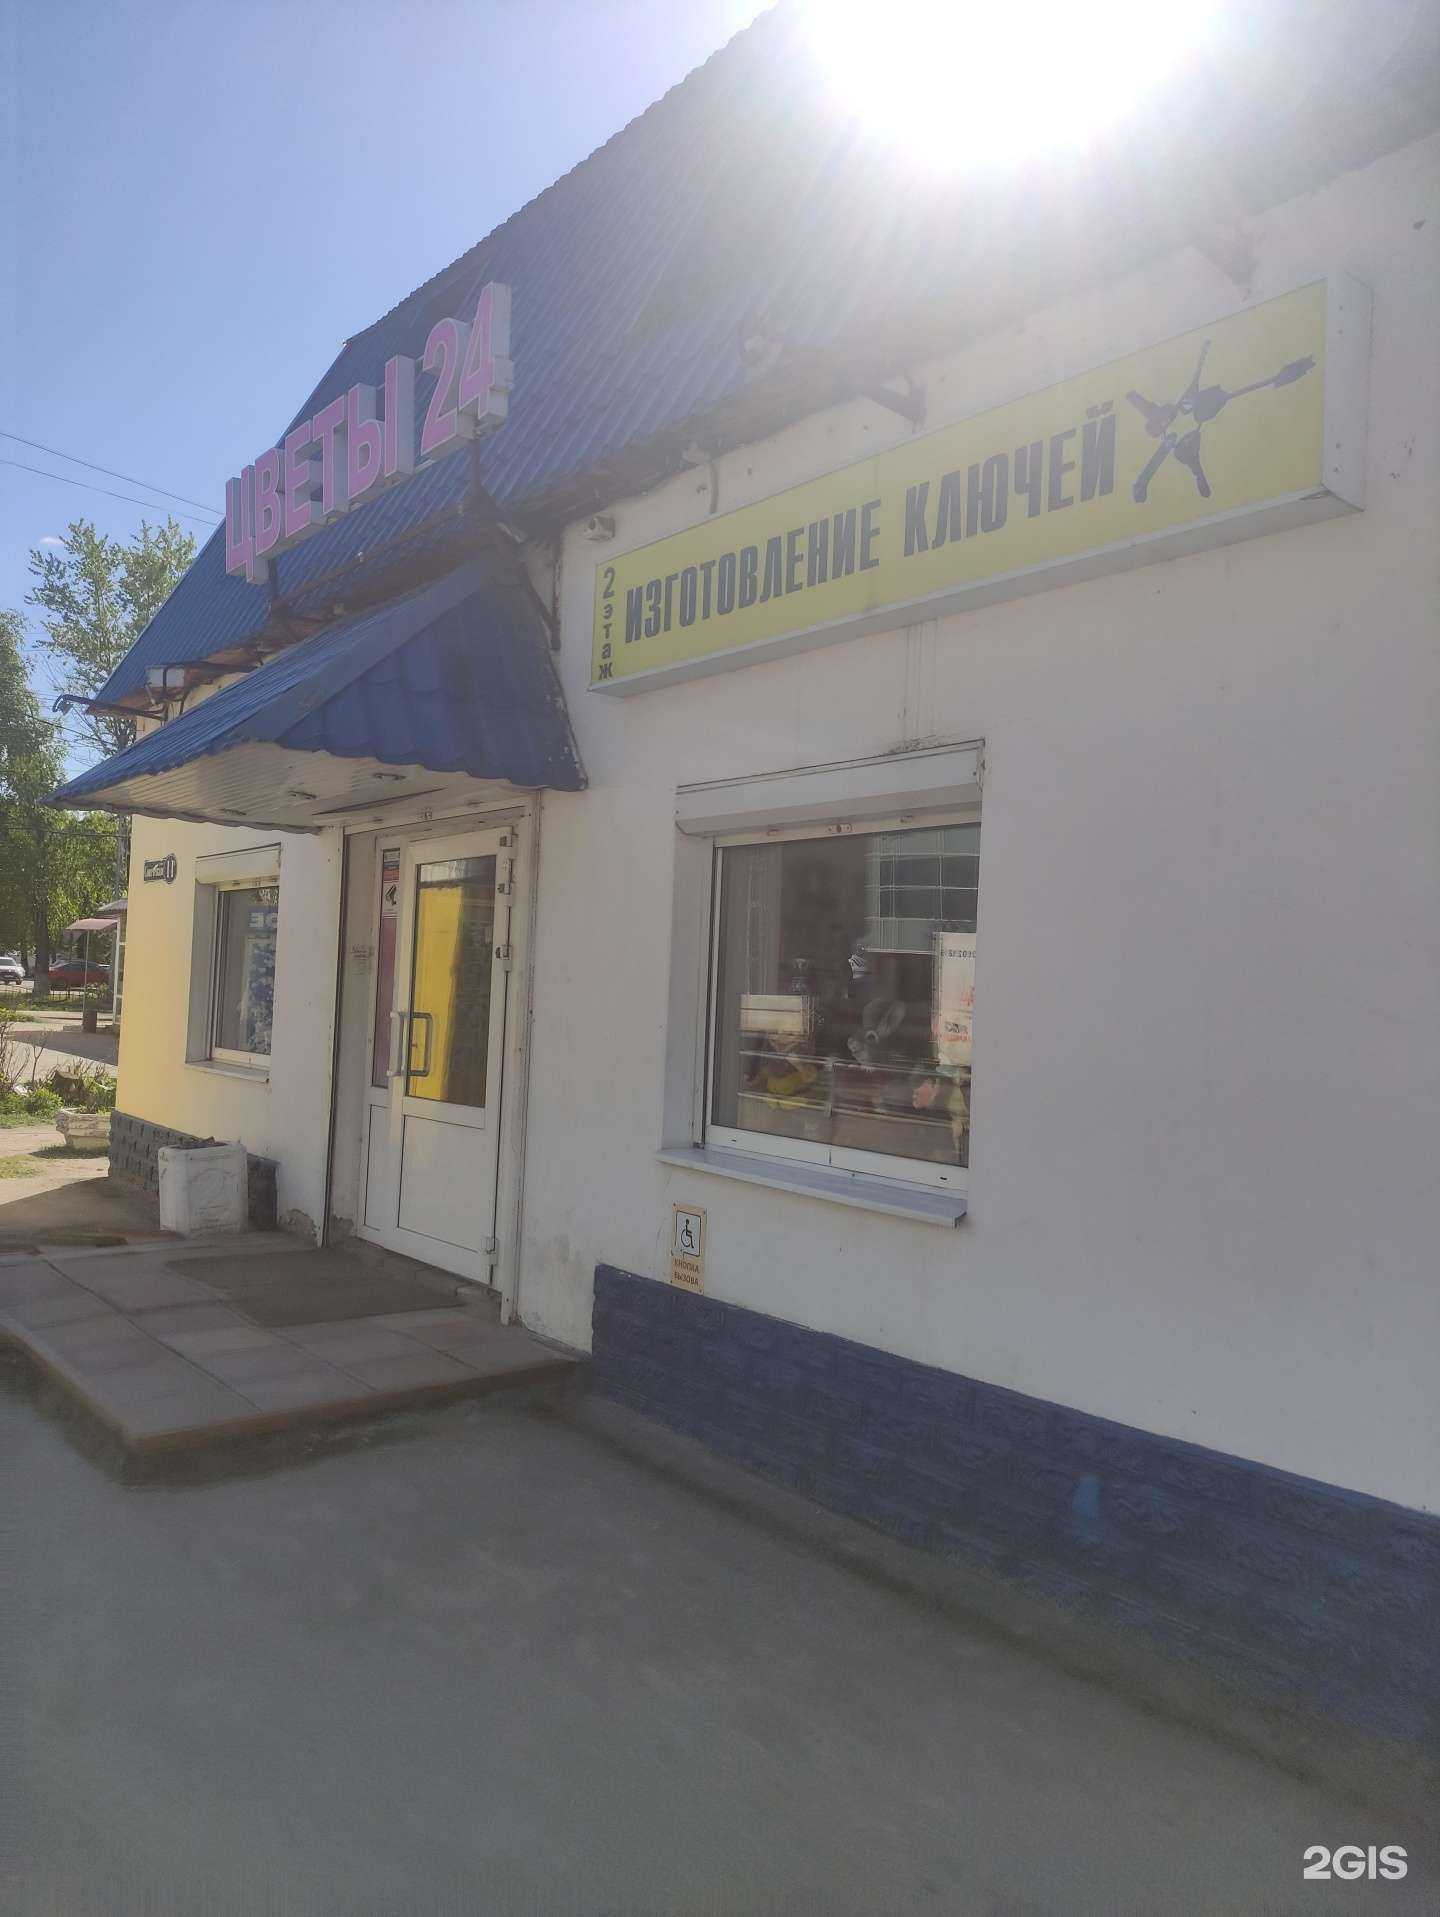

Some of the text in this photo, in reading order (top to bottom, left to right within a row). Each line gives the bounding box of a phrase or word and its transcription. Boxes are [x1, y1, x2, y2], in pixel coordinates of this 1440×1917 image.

[225, 281, 502, 584] ЦВЕТЫ 24
[625, 400, 1116, 643] ИЗГОТОВЛЕНИЕ КЛЮЧЕЙ
[603, 567, 616, 599] 2
